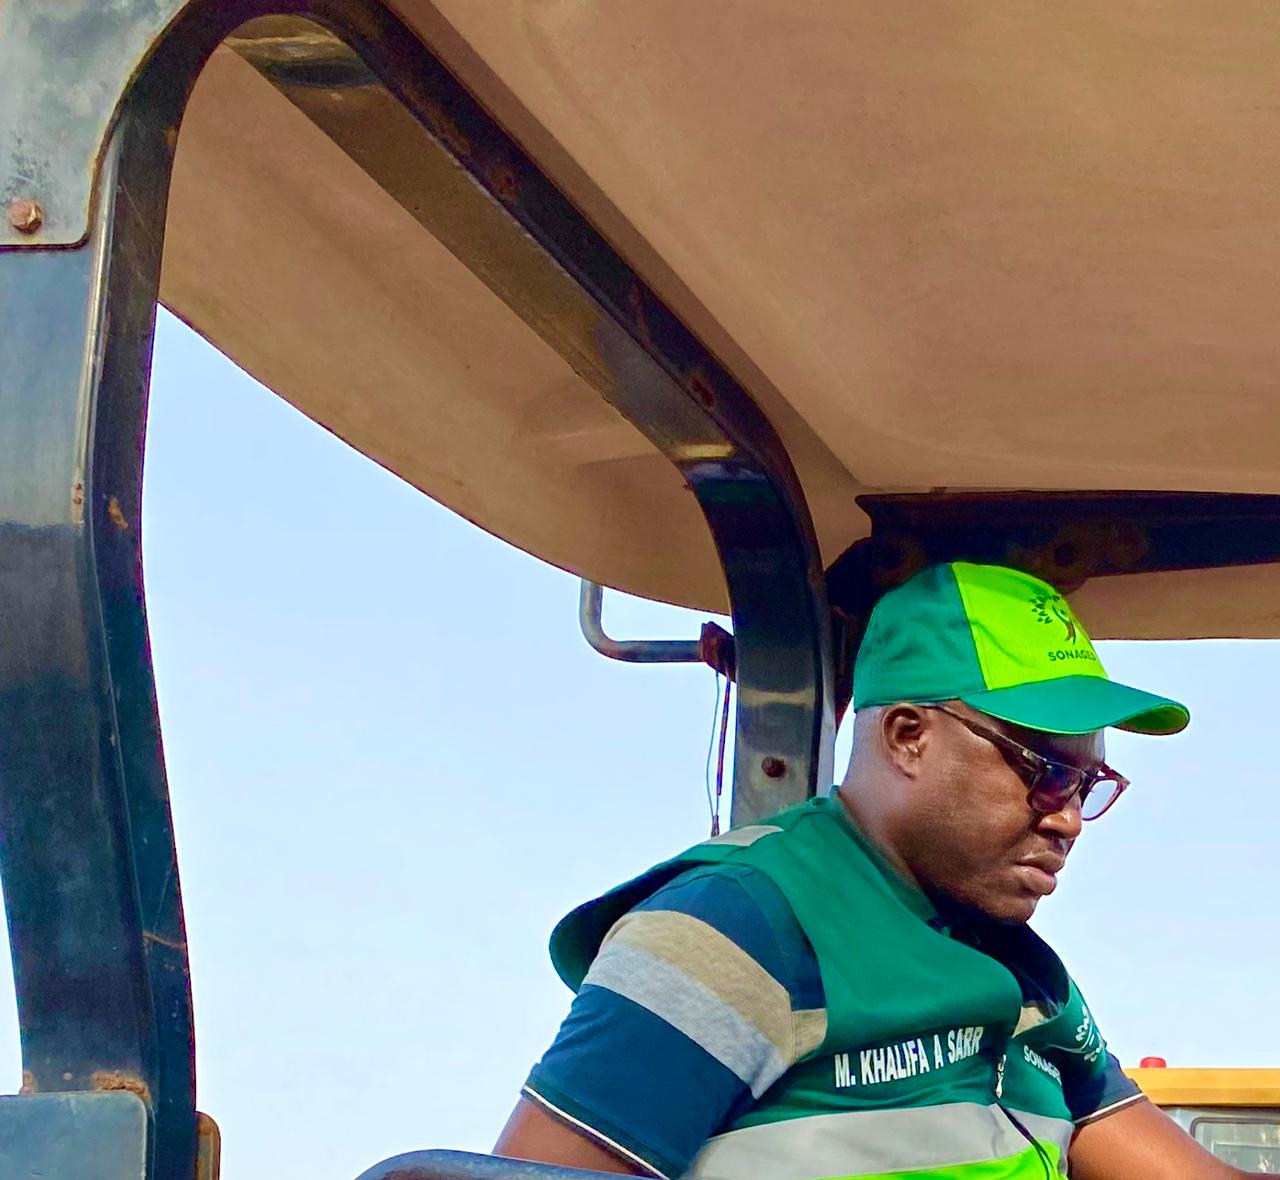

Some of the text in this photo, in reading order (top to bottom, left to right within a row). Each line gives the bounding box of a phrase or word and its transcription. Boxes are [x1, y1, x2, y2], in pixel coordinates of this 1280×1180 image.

[834, 1026, 984, 1088] M. KHALIFA A SARR
